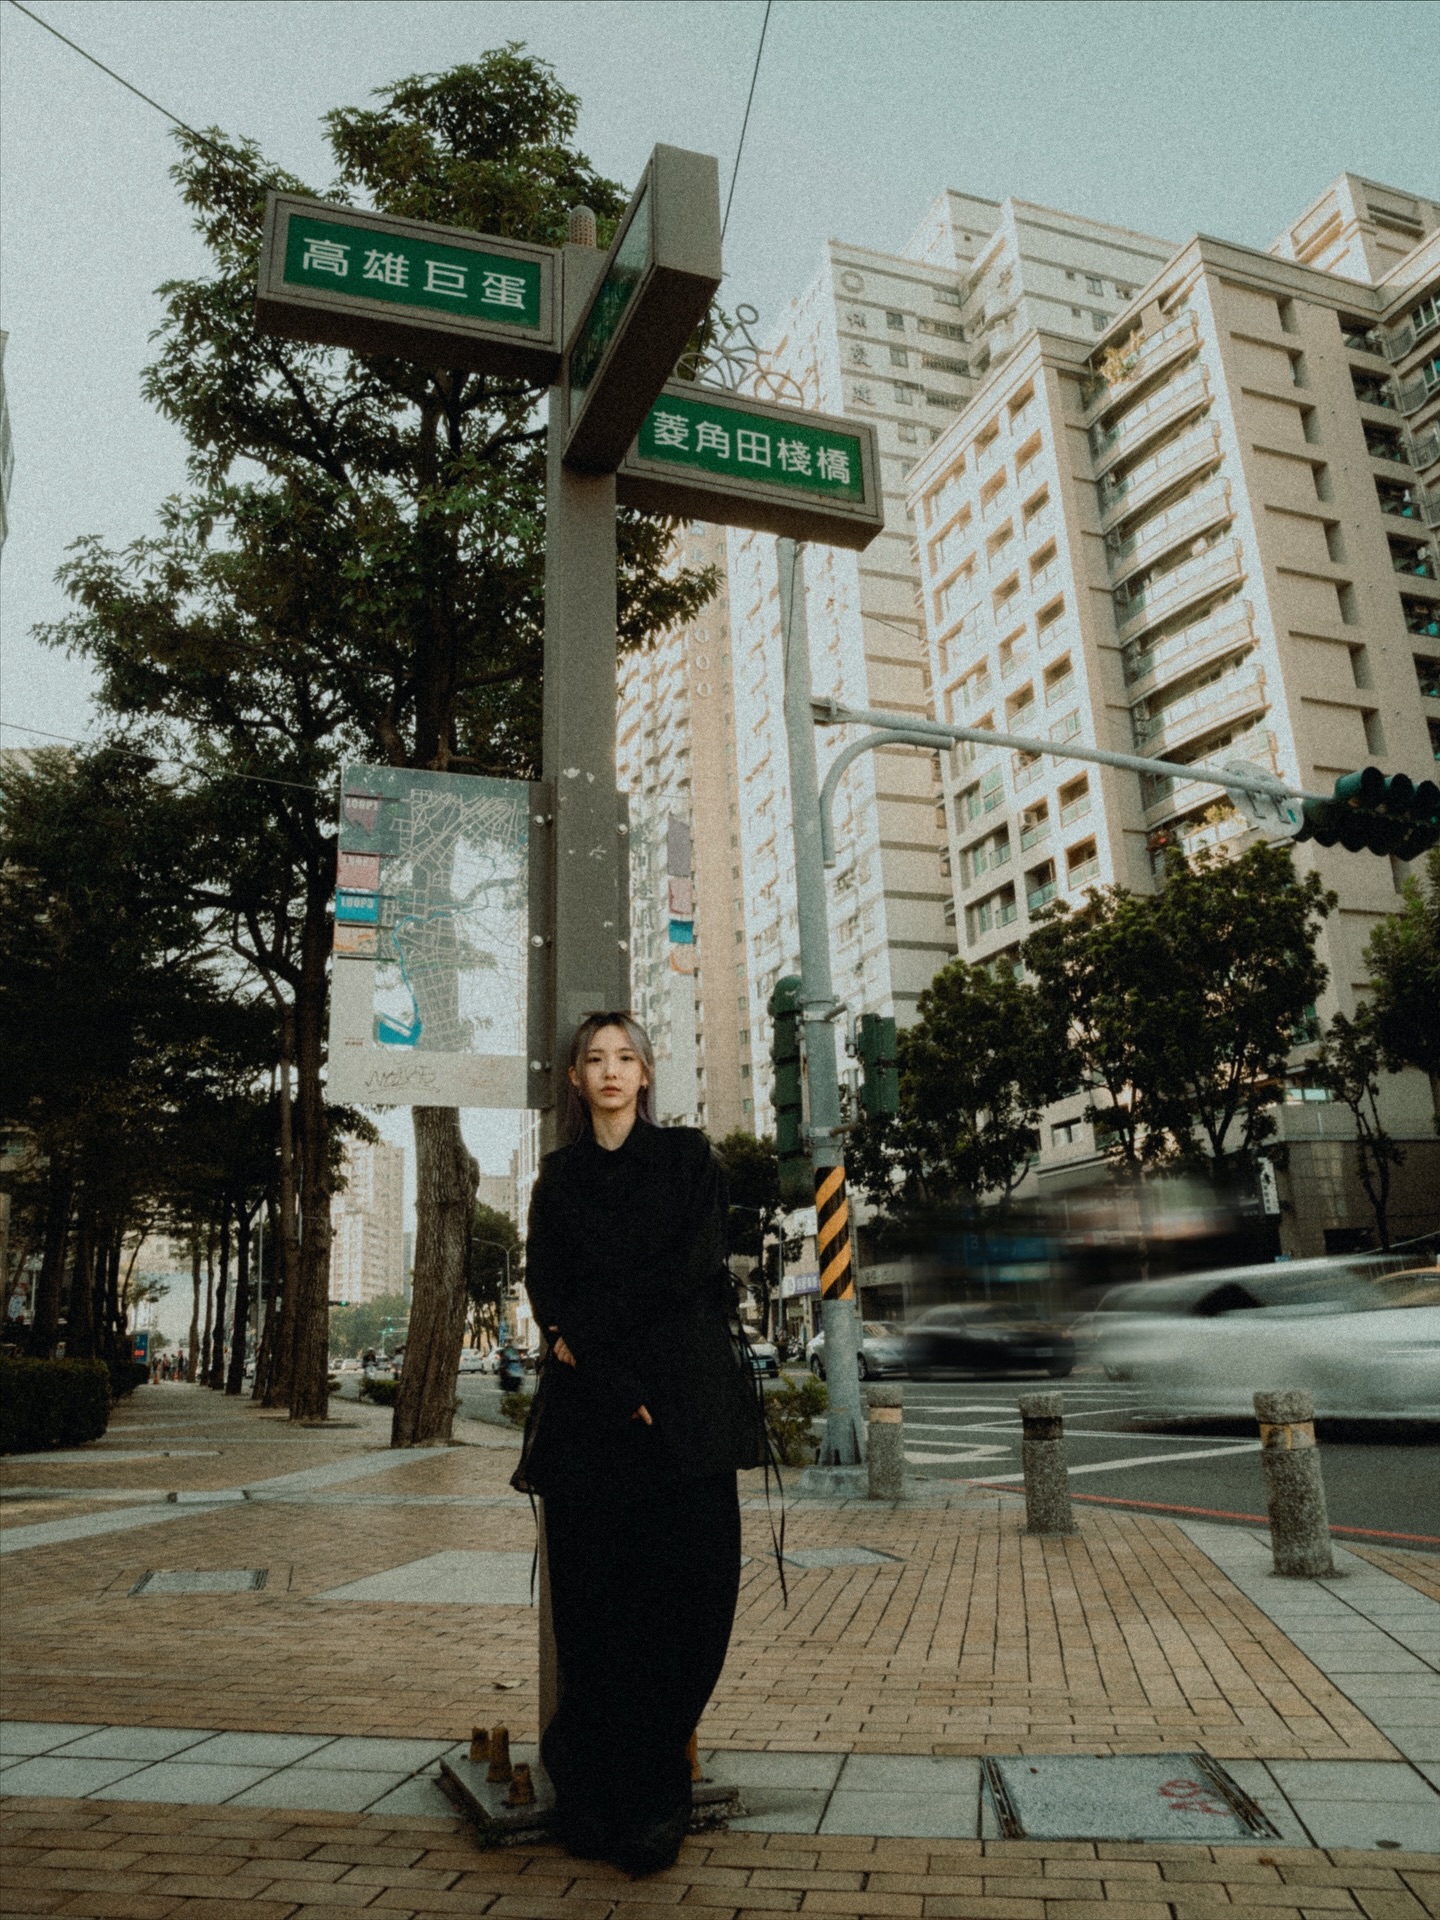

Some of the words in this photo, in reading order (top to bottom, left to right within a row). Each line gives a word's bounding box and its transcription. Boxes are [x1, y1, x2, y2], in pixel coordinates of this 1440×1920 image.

[302, 238, 526, 309] 高雄巨蛋
[653, 411, 850, 483] 菱角田棧橋
